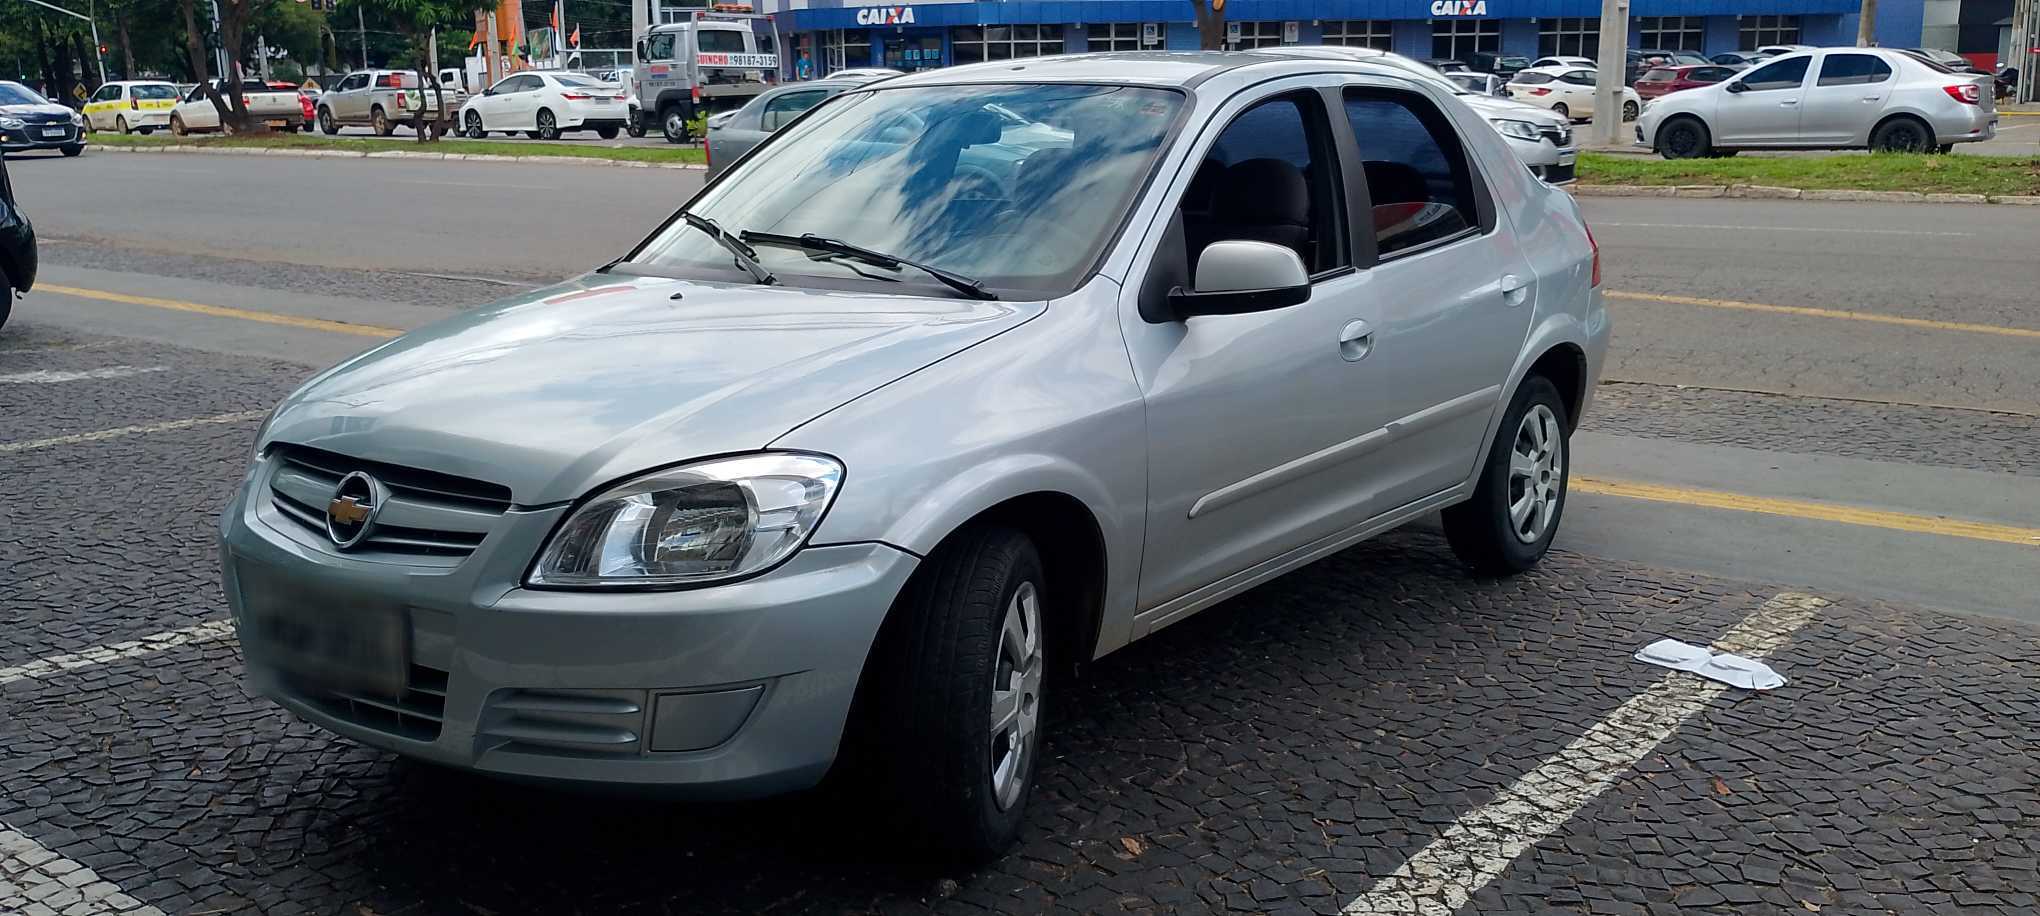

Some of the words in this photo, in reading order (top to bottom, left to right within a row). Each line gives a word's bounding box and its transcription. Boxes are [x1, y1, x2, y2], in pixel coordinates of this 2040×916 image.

[1431, 0, 1486, 16] CAIXA
[857, 7, 915, 26] CAIXA
[733, 55, 777, 66] 98187-3159
